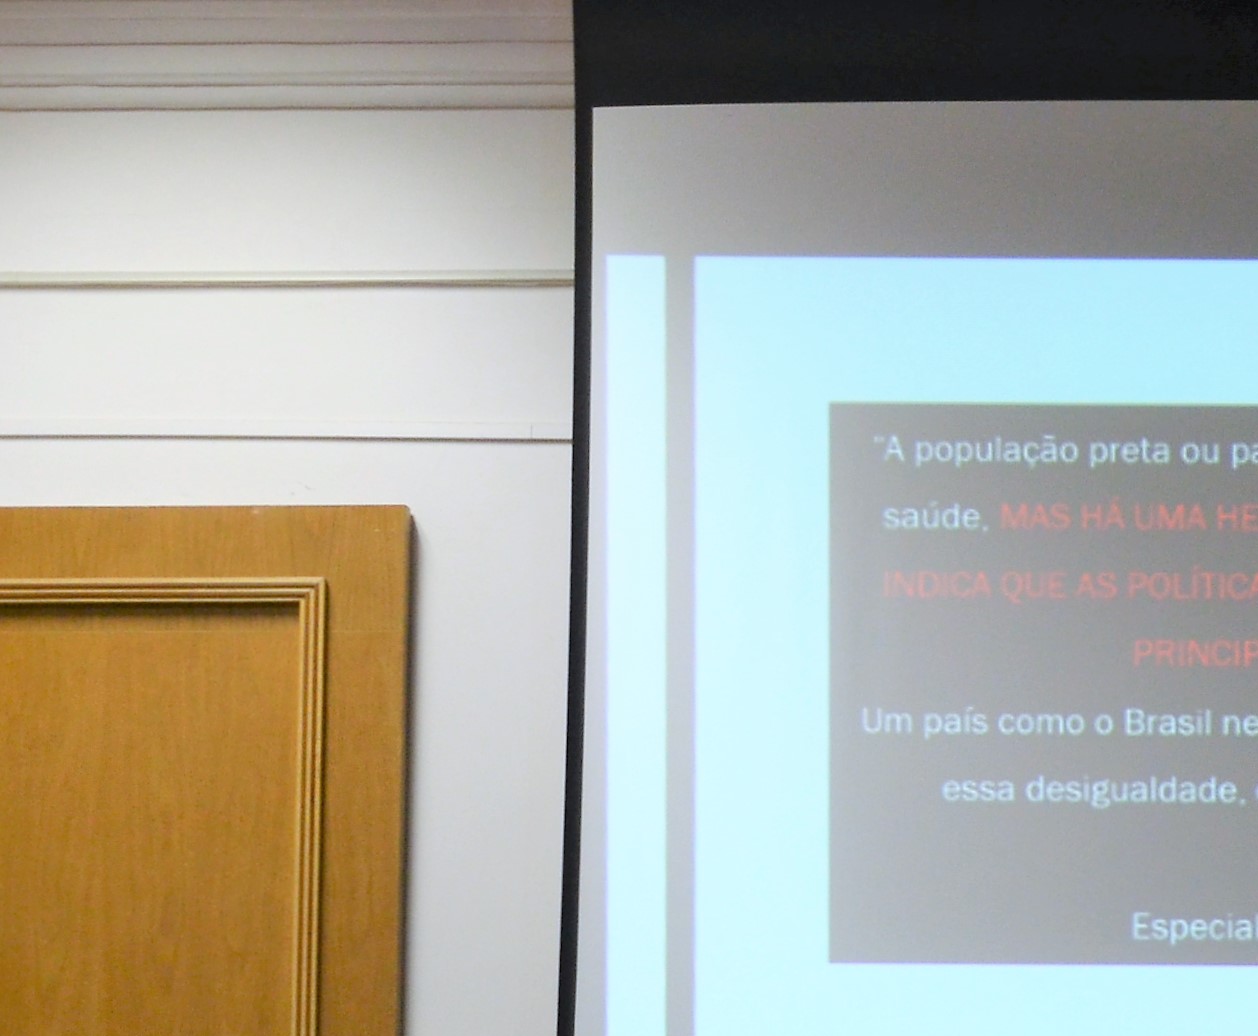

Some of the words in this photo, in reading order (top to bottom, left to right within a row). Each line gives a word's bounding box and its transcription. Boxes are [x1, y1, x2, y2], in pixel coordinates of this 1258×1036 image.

[915, 434, 1079, 468] população
[1090, 438, 1171, 468] preta
[1182, 440, 1219, 465] ou
[1001, 504, 1070, 530] MAS
[1081, 497, 1126, 530] HÁ
[1134, 505, 1207, 531] UMA
[1001, 571, 1067, 603] QUE
[1074, 572, 1117, 599] AS
[861, 707, 912, 734] Um
[924, 706, 988, 738] país
[999, 714, 1085, 735] como
[1094, 715, 1113, 735] o
[1124, 708, 1211, 736] Brasil
[943, 781, 1014, 802] essa
